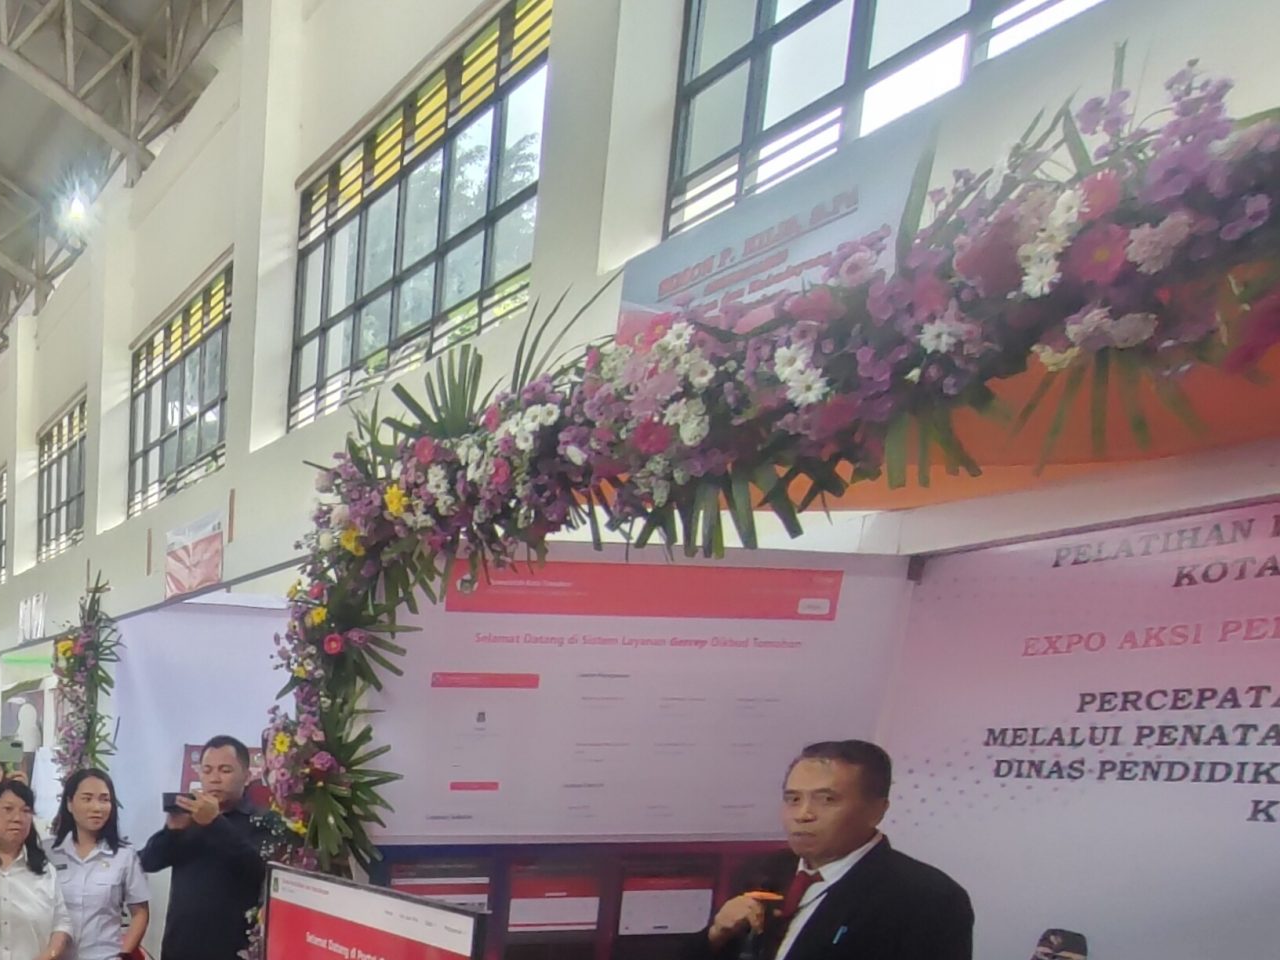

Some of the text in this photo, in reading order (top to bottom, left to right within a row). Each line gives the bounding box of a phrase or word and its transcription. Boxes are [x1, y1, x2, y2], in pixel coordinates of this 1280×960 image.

[1052, 518, 1256, 568] PELATIHAN
[1021, 632, 1107, 657] EXPO
[1117, 623, 1203, 650] AKSI
[983, 726, 1123, 748] MELALUI
[993, 759, 1086, 780] DINAS
